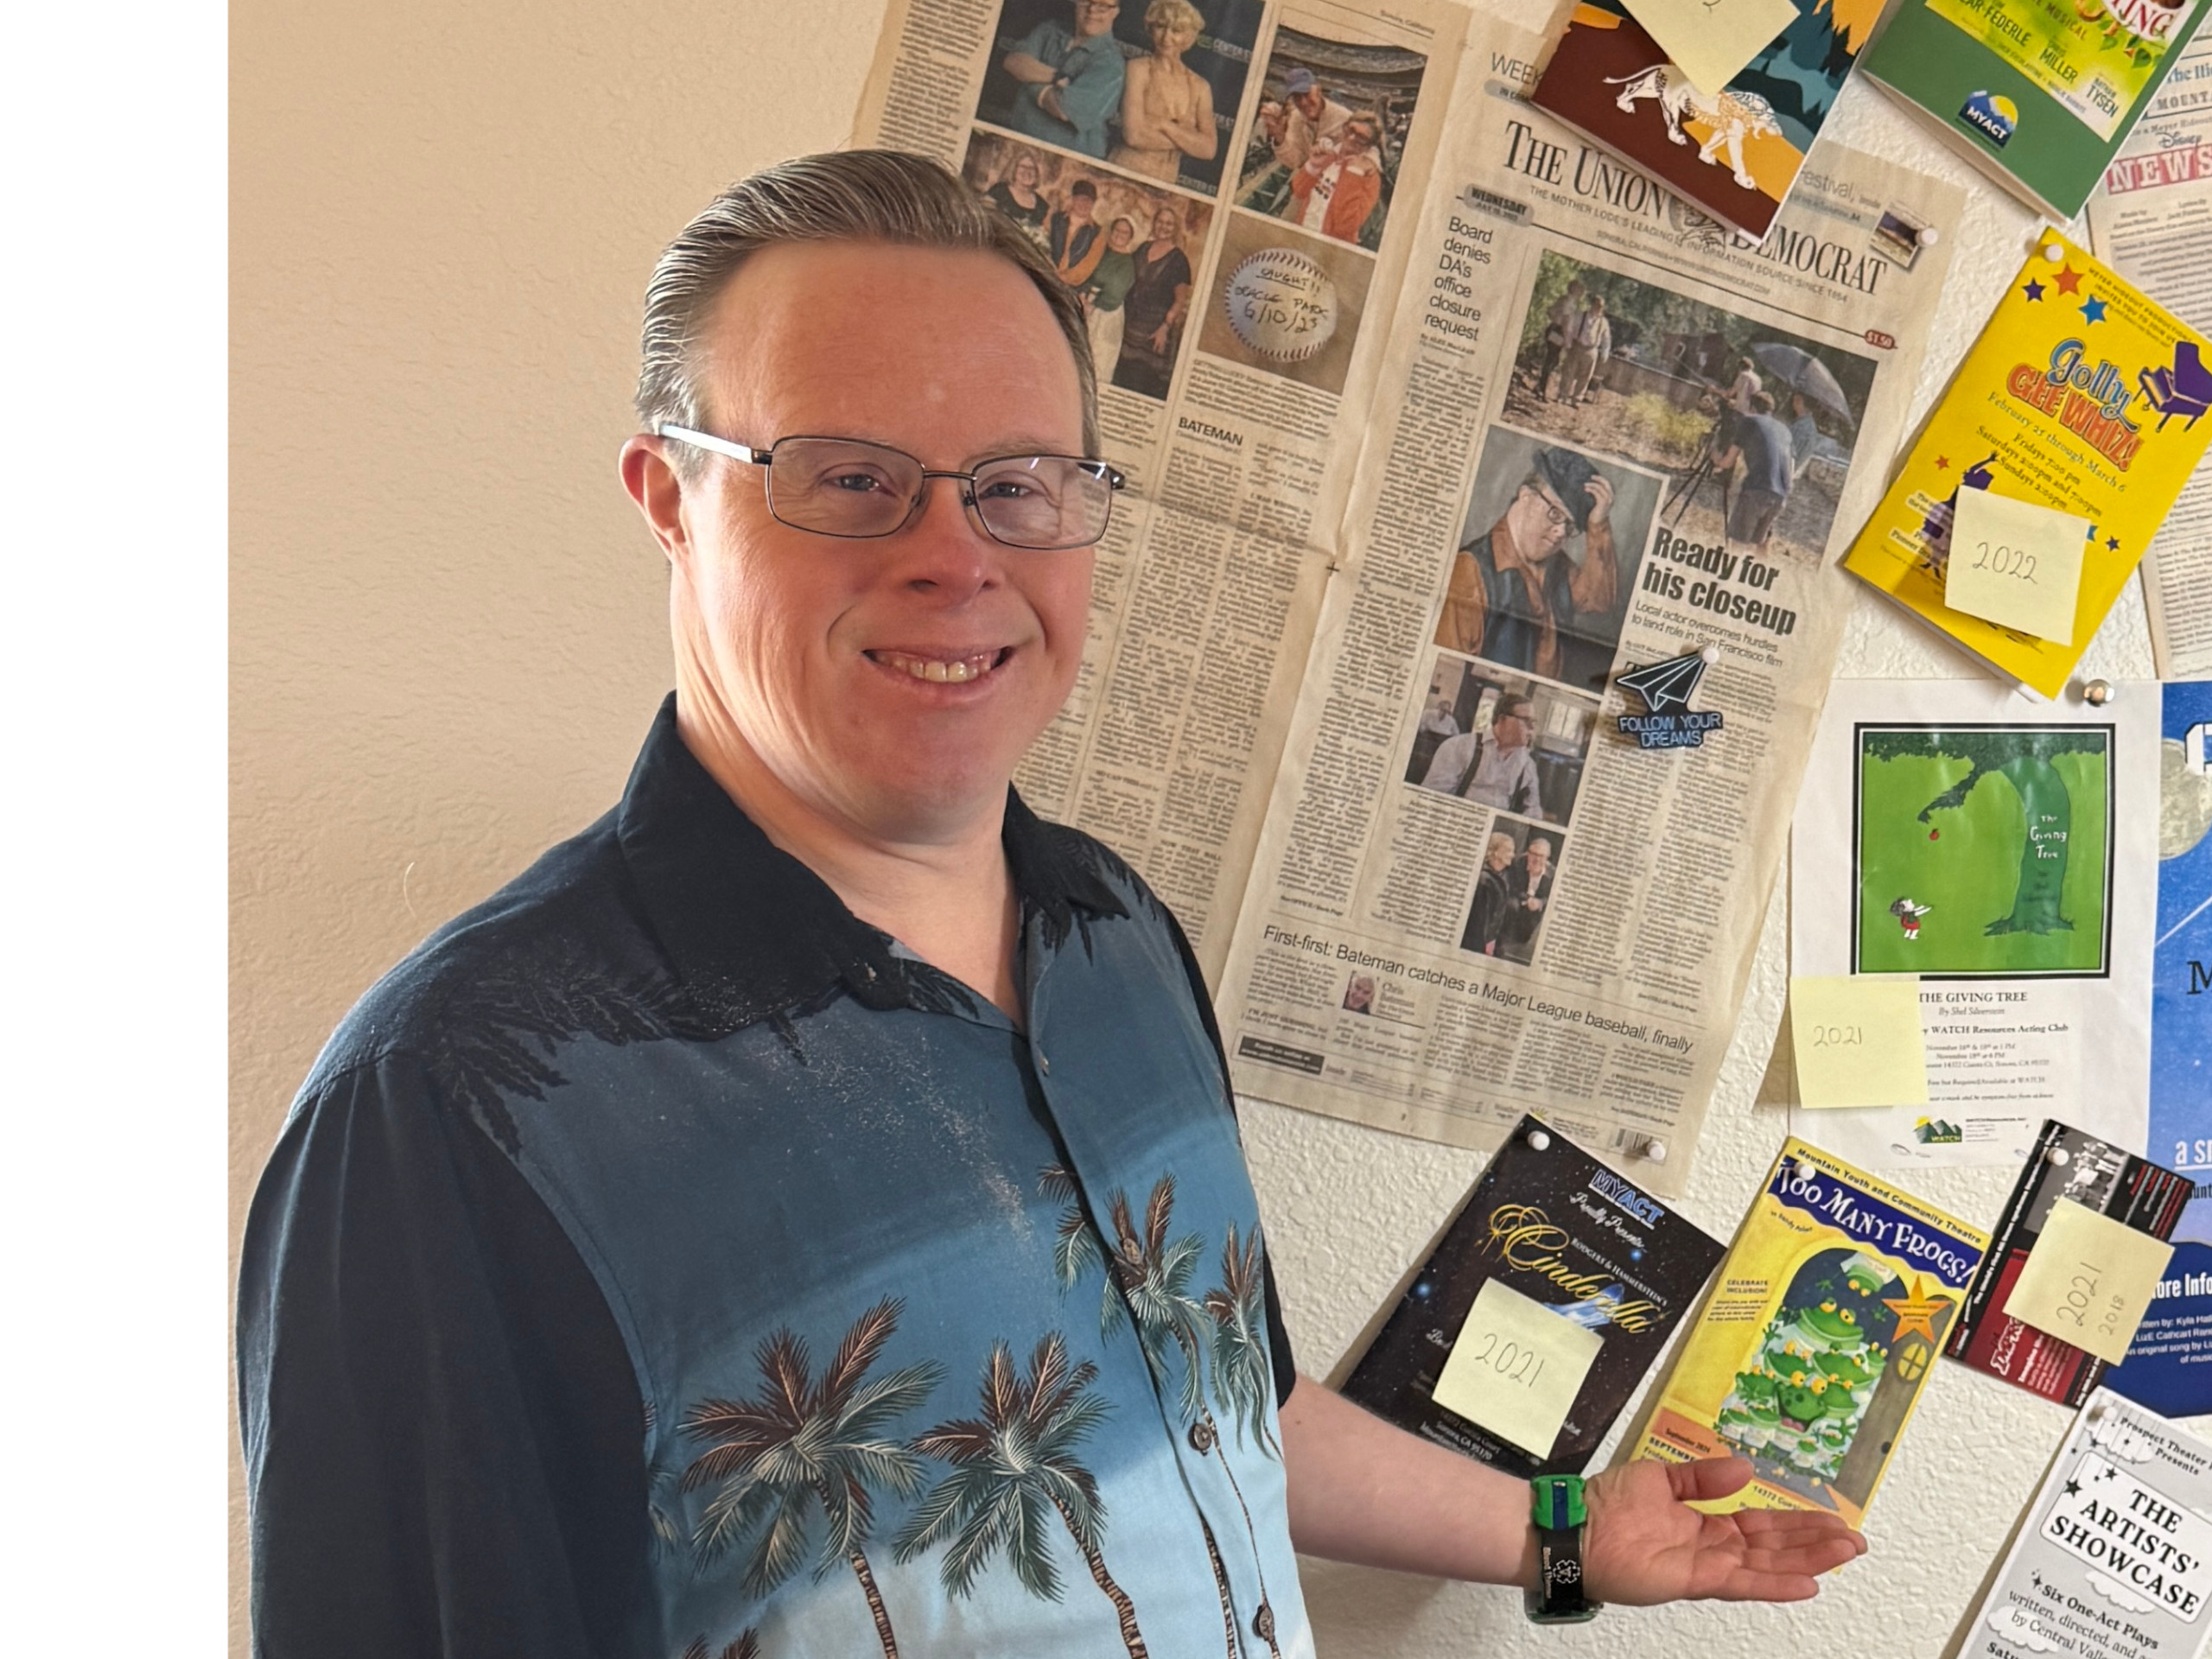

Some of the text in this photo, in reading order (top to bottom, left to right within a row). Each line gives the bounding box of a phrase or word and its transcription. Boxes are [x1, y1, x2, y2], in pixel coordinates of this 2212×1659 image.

[1984, 5, 2032, 48] FEDERLE
[2045, 3, 2088, 41] MUSICAL
[2112, 0, 2174, 40] ING
[2039, 48, 2079, 85] MILLER
[2086, 85, 2120, 118] TYSEN
[1967, 105, 2008, 140] MYACT
[1503, 119, 1568, 186] THE
[1573, 145, 1669, 220] UNION
[1471, 188, 1528, 215] WEDNESDAY
[1449, 216, 1493, 244] Board
[1530, 185, 1548, 200] THE
[1551, 193, 1592, 214] MOTHER
[1594, 205, 1630, 226] LODE'S
[1631, 219, 1674, 245] LEADING
[1688, 242, 1754, 271] INFORMATION
[1756, 264, 1794, 285] SOURCE
[1796, 276, 1824, 296] SINCE
[1439, 254, 1472, 278] DA's
[1444, 238, 1491, 264] denies
[1434, 276, 1471, 298] office
[1244, 302, 1318, 333] 6/10/23
[1425, 314, 1479, 341] request
[1429, 294, 1482, 321] closure
[1866, 332, 1892, 347] $1.50
[2007, 363, 2066, 418] GEE
[1179, 416, 1243, 446] BATEMAN
[1988, 391, 2032, 428] February
[2046, 432, 2084, 465] through
[2086, 461, 2117, 487] March
[2118, 484, 2126, 493] 6
[1976, 425, 2102, 518] Saturdays 2:00pm and 7:00pm
[2013, 433, 2081, 486] Fridays 7:00 pm
[1999, 456, 2068, 510] Sundays 2:00pm
[1652, 526, 1780, 592] Ready for
[1973, 542, 2038, 585] 2022
[1642, 562, 1797, 636] his closeup
[1631, 614, 1783, 668] to land role in San Francisco film
[1636, 600, 1778, 653] Local actor overcomes hurdles
[1618, 713, 1721, 732] FOLLOW YOUR
[1642, 730, 1702, 747] DREAMS
[2030, 825, 2068, 842] Giving
[2036, 844, 2058, 859] Tree
[1263, 925, 1694, 1055] First-first: Bateman catches a Major League baseball, finally
[1946, 993, 1993, 1003] GIVING
[1996, 992, 2029, 1002] TREE
[1931, 1024, 2069, 1034] WATCH Resources Acting Club
[1938, 1007, 1949, 1017] By
[1950, 1007, 1967, 1016] Shel
[1813, 1026, 1863, 1047] 2021
[1931, 1135, 1961, 1143] WATCH
[1591, 1168, 1665, 1224] MYACT
[1797, 1147, 1981, 1244] Mountain Youth and Community Theatre
[1569, 1192, 1607, 1224] Proudly
[1605, 1215, 1647, 1252] Presents
[1777, 1161, 1978, 1284] TOO MANY FROGS!
[1572, 1237, 1605, 1265] RODGERS
[1611, 1265, 1669, 1306] HAMMERSTEIN'S
[2056, 1262, 2101, 1327] 2021
[1475, 1333, 1544, 1388] 2021
[2137, 1341, 2202, 1356] original song by
[1460, 1434, 1471, 1446] CA
[2120, 1416, 2207, 1466] Prospect Theater
[2155, 1447, 2199, 1475] Presents
[2128, 1489, 2183, 1534] THE
[2080, 1499, 2200, 1574] ARTISTS'
[2050, 1516, 2200, 1616] SHOWCASE
[2009, 1590, 2137, 1659] written, directed, and
[2012, 1610, 2075, 1650] by Central
[2042, 1584, 2159, 1650] Six One-Act Plays
